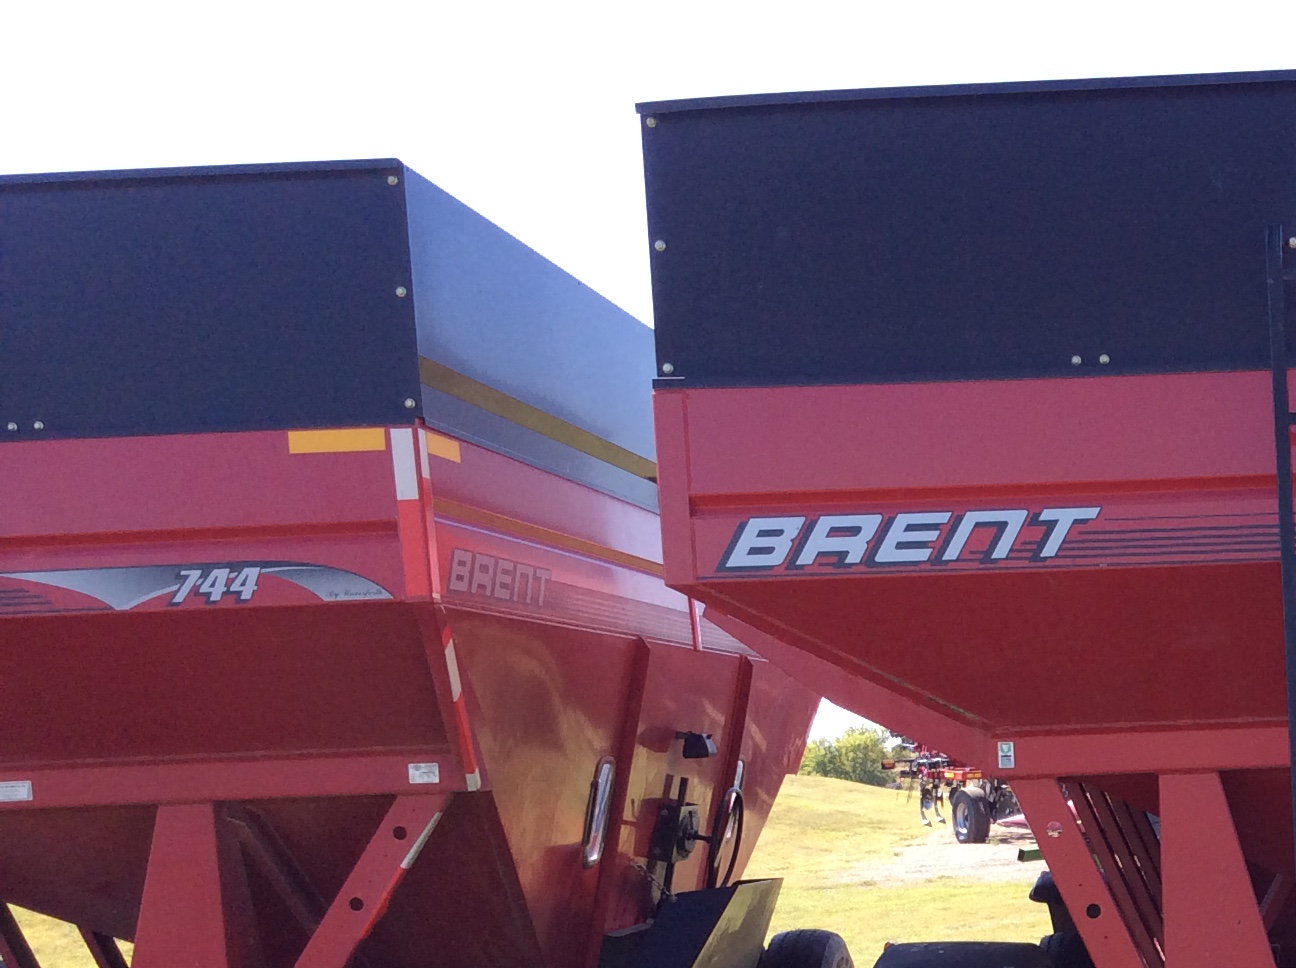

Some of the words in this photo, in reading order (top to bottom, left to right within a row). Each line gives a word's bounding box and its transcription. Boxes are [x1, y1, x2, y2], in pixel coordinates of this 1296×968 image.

[721, 506, 1101, 569] BRENT
[171, 566, 260, 603] 744
[448, 547, 552, 607] BRENT
